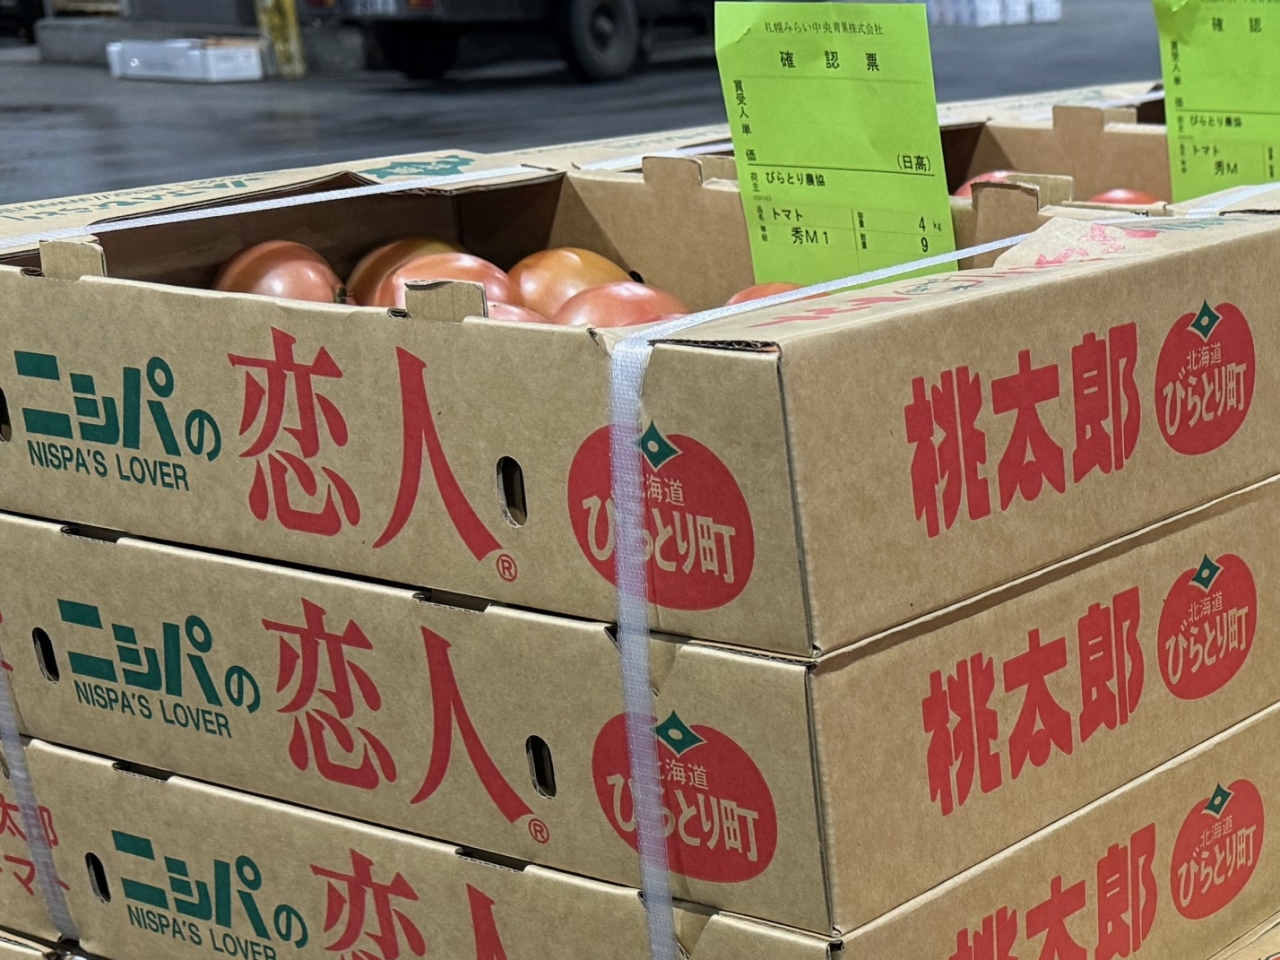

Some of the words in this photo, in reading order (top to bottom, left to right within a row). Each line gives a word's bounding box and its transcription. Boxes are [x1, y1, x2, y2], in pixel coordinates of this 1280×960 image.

[764, 21, 884, 36] 札幌みらい中央青果株式会社
[779, 50, 880, 72] 確認票
[765, 171, 826, 187] びらとり農協
[772, 207, 803, 222] トマト
[921, 237, 929, 253] 9
[1186, 341, 1222, 372] 北海道
[1162, 362, 1247, 436] びらとり町
[230, 329, 501, 560] 恋人
[905, 323, 1140, 537] 桃太郎
[28, 439, 109, 478] NISPA'S
[117, 455, 190, 492] LOVER
[1188, 591, 1223, 625] 北海道
[1165, 605, 1248, 685] びらとり町
[75, 679, 153, 720] NISPA'S
[160, 702, 232, 740] LOVER
[264, 600, 531, 822] 恋人
[922, 587, 1144, 815] 桃太郎
[1200, 815, 1233, 850] 北海道
[1178, 825, 1257, 906] びらとり町
[127, 904, 203, 946] NISPA'S
